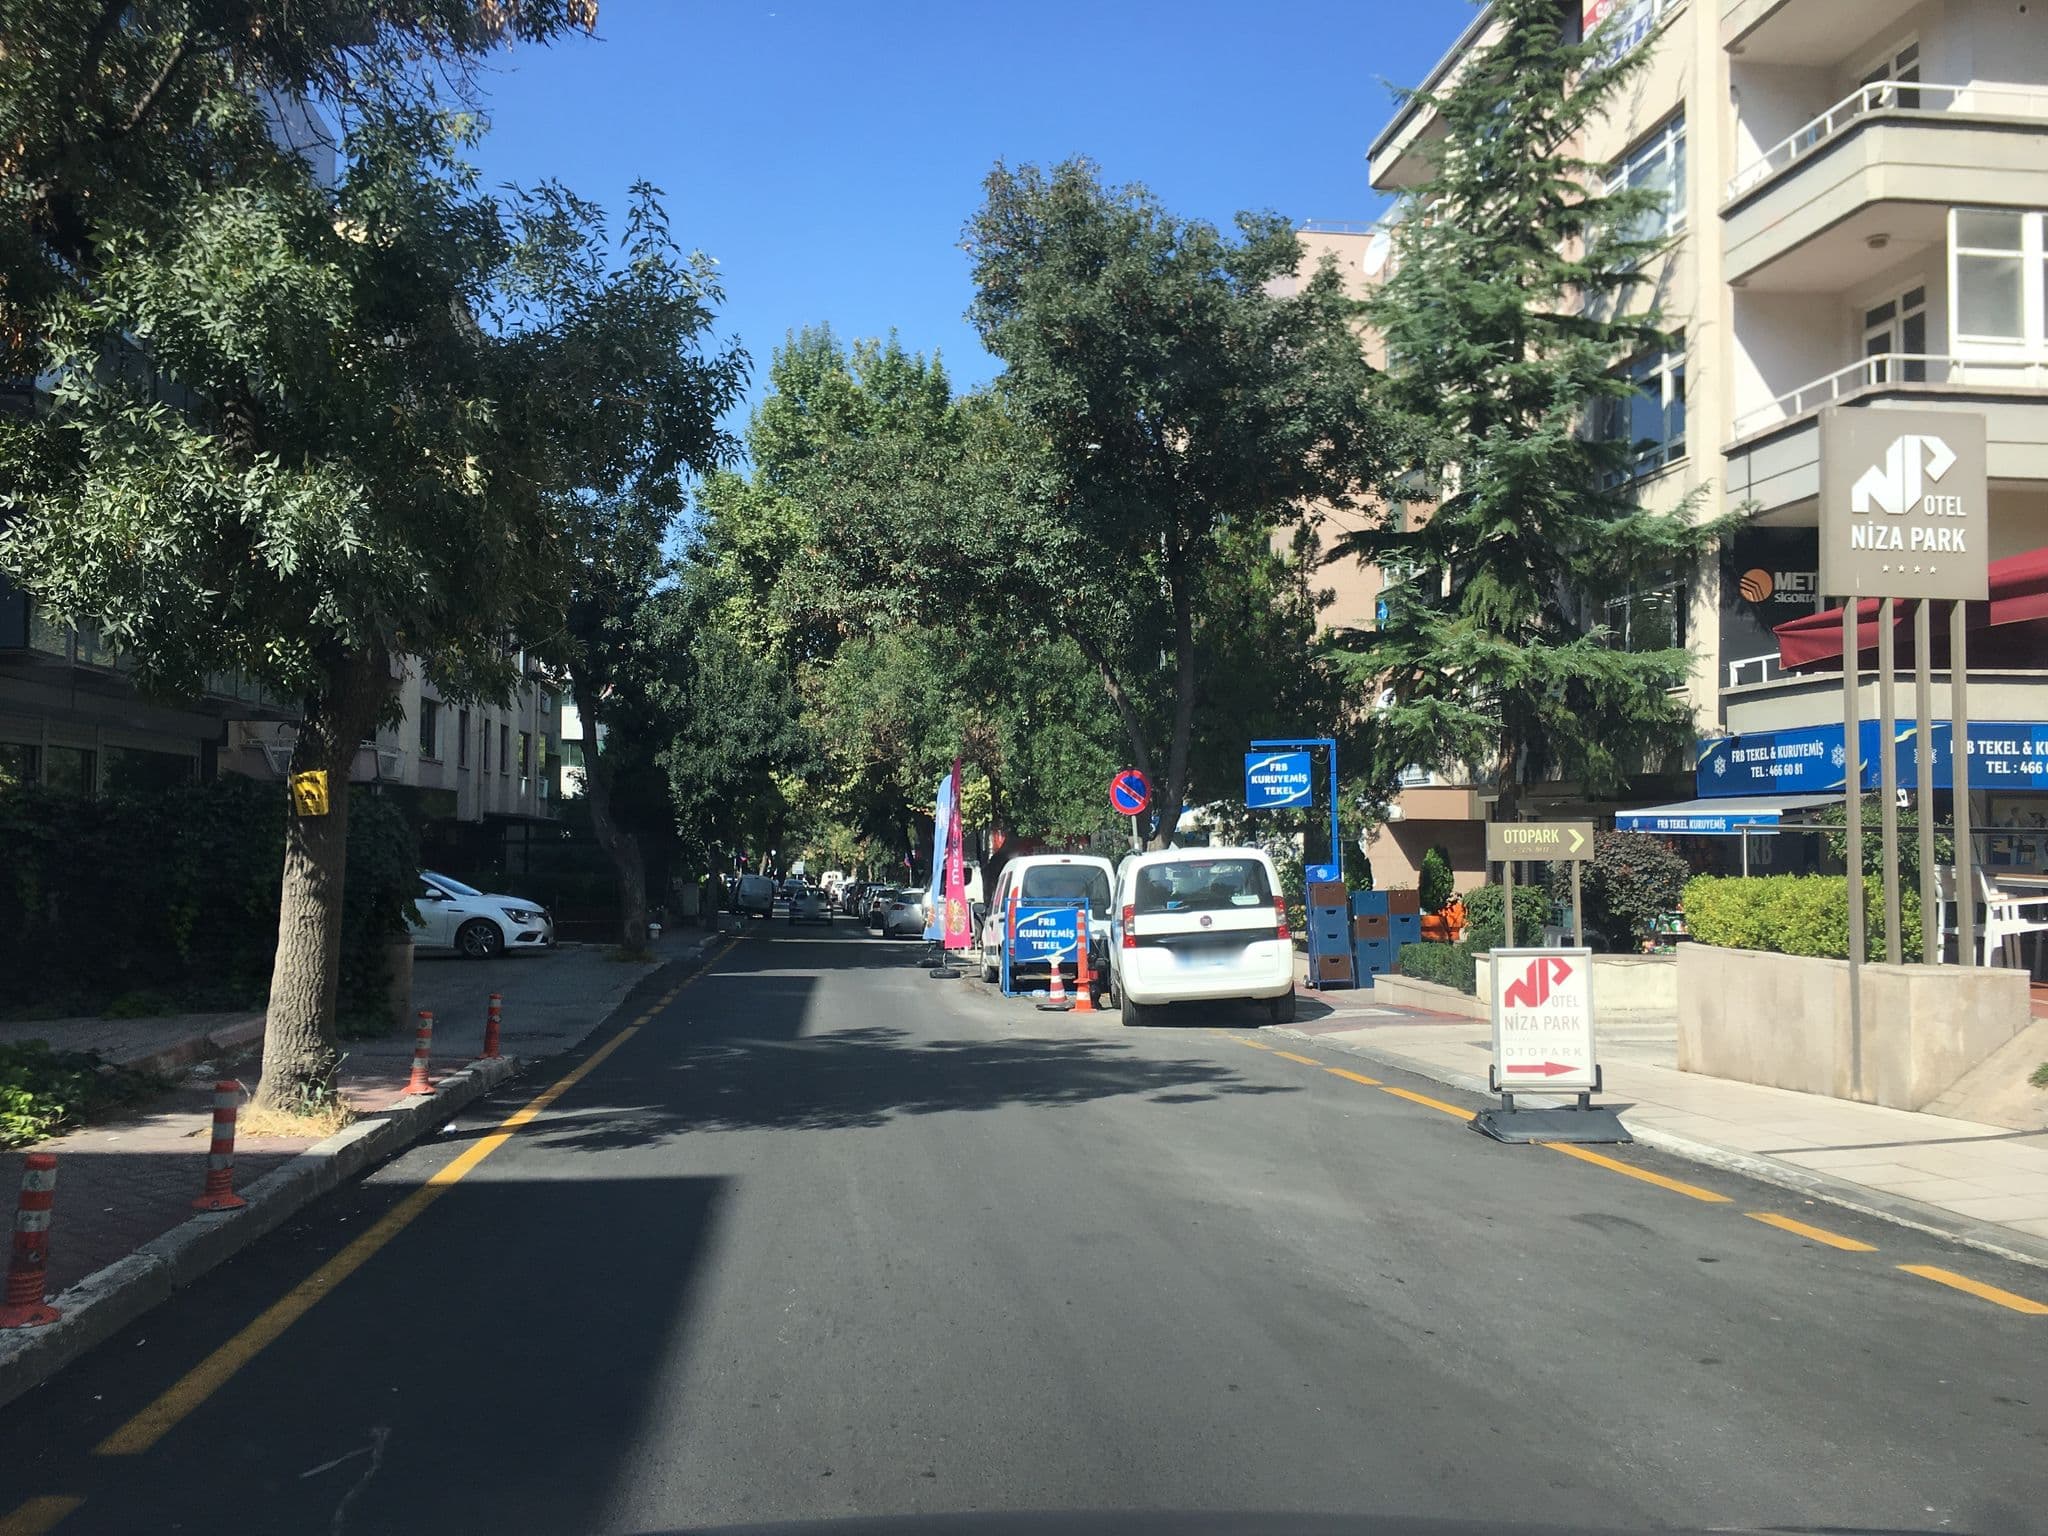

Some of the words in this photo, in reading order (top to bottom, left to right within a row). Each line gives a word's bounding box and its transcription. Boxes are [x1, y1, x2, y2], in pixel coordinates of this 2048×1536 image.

[1923, 495, 1967, 517] OTEL
[1851, 521, 1904, 551] NİZA
[1910, 527, 1967, 552] PARK
[1731, 749, 1745, 763] FRB
[1746, 747, 1769, 762] TEKEL
[1770, 746, 1777, 759] &
[1777, 740, 1824, 759] KURUYEMİŞ
[1977, 740, 2020, 755] TEKEL
[2022, 740, 2033, 755] &
[1269, 763, 1288, 772] FRB
[1750, 766, 1764, 778] TEL
[1769, 764, 1783, 777] 466
[1783, 763, 1793, 775] 60
[1794, 763, 1803, 775] 81
[1985, 760, 2011, 773] TEL
[2020, 760, 2043, 774] 466
[1251, 772, 1308, 784] KURUYEMİŞ
[1264, 786, 1296, 796] TEKEL
[1657, 818, 1669, 829] FRB
[1670, 818, 1688, 829] TEKEL
[1689, 817, 1726, 832] KURUYEMİŞ
[1503, 828, 1560, 844] OTOPARK
[1038, 917, 1056, 927] FRB
[1018, 928, 1076, 940] KURUYEMİŞ
[1031, 941, 1062, 950] TEKEL
[1551, 994, 1581, 1008] OTEL
[1504, 1012, 1539, 1031] NİZA
[1543, 1015, 1581, 1031] PARK
[1505, 1047, 1583, 1057] OTOPARK
